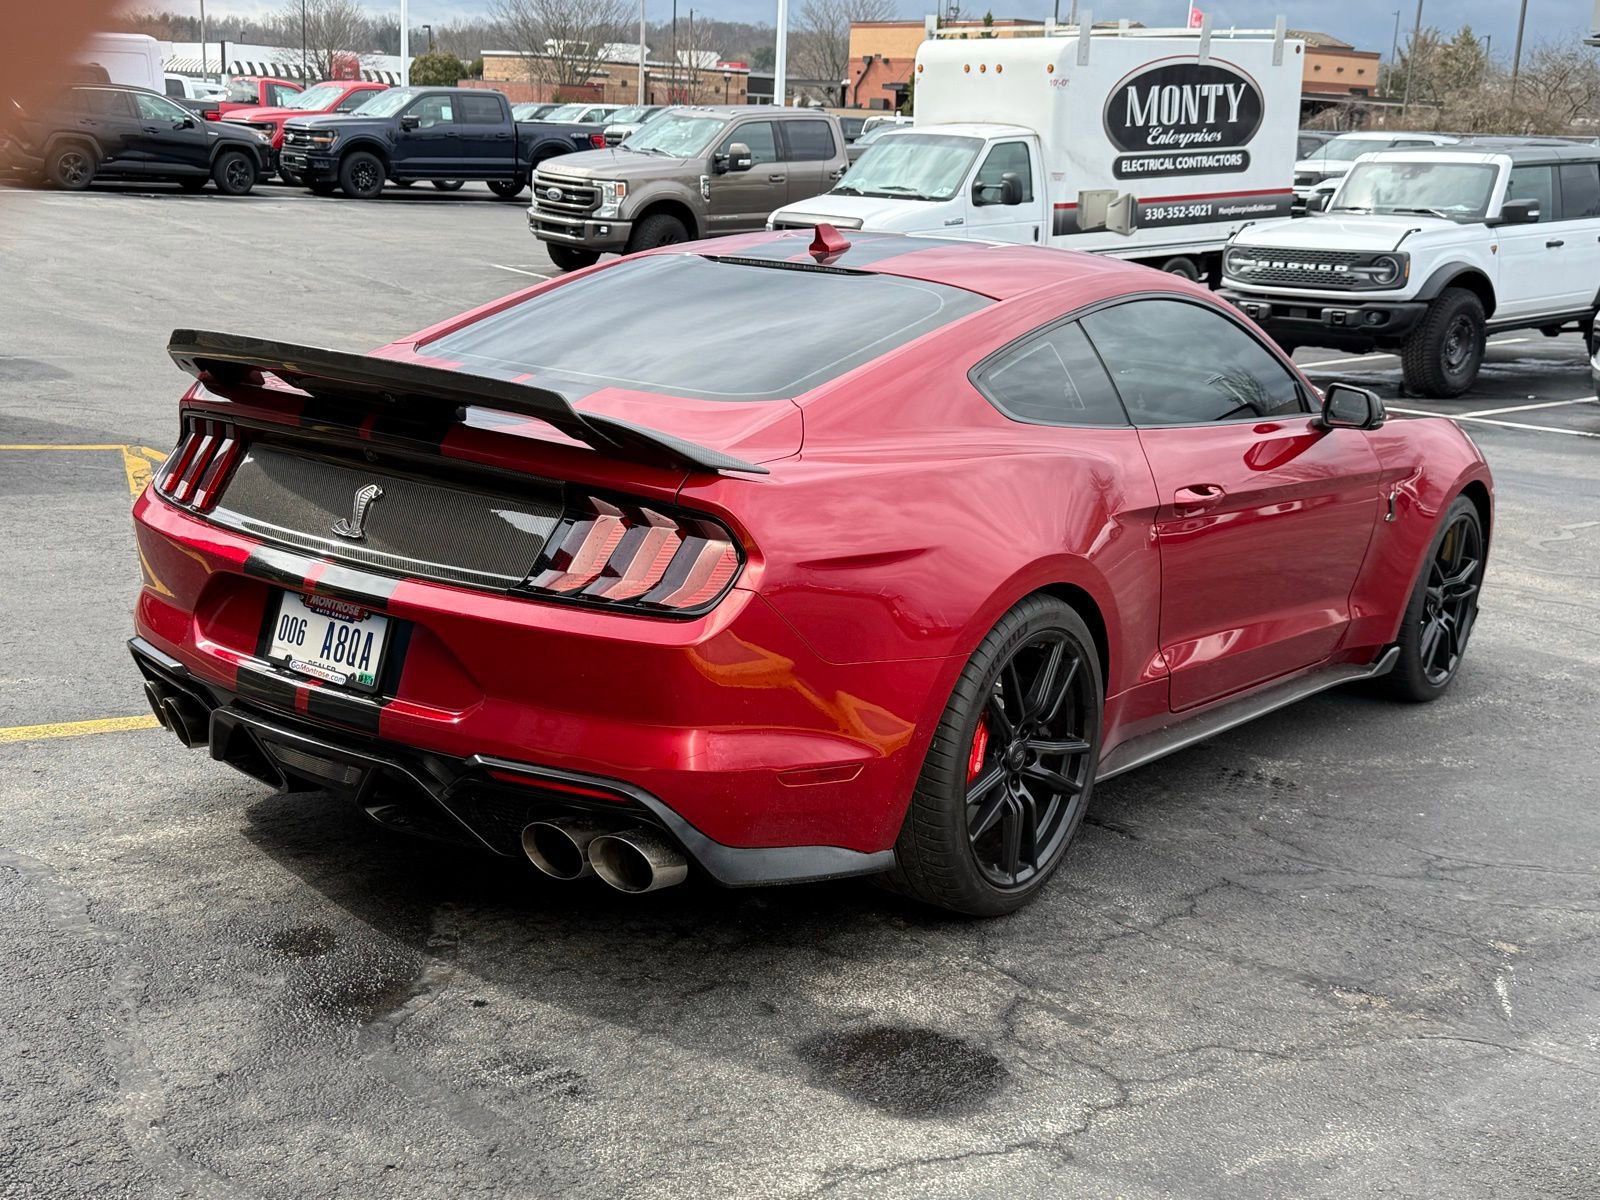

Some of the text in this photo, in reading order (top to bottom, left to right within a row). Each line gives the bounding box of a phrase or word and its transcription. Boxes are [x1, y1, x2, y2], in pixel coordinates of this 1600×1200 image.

[1124, 83, 1247, 127] MONTY
[1146, 127, 1222, 148] Enterprises
[1121, 153, 1243, 172] ELECTRICAL CONTRACTORS
[1145, 204, 1212, 220] 330-352-5021
[1257, 260, 1349, 272] BRONCO
[310, 594, 361, 616] MONTROSE
[316, 607, 331, 615] AUTO
[278, 614, 374, 671] 006 A8QA
[290, 660, 345, 684] GoMontrose.com
